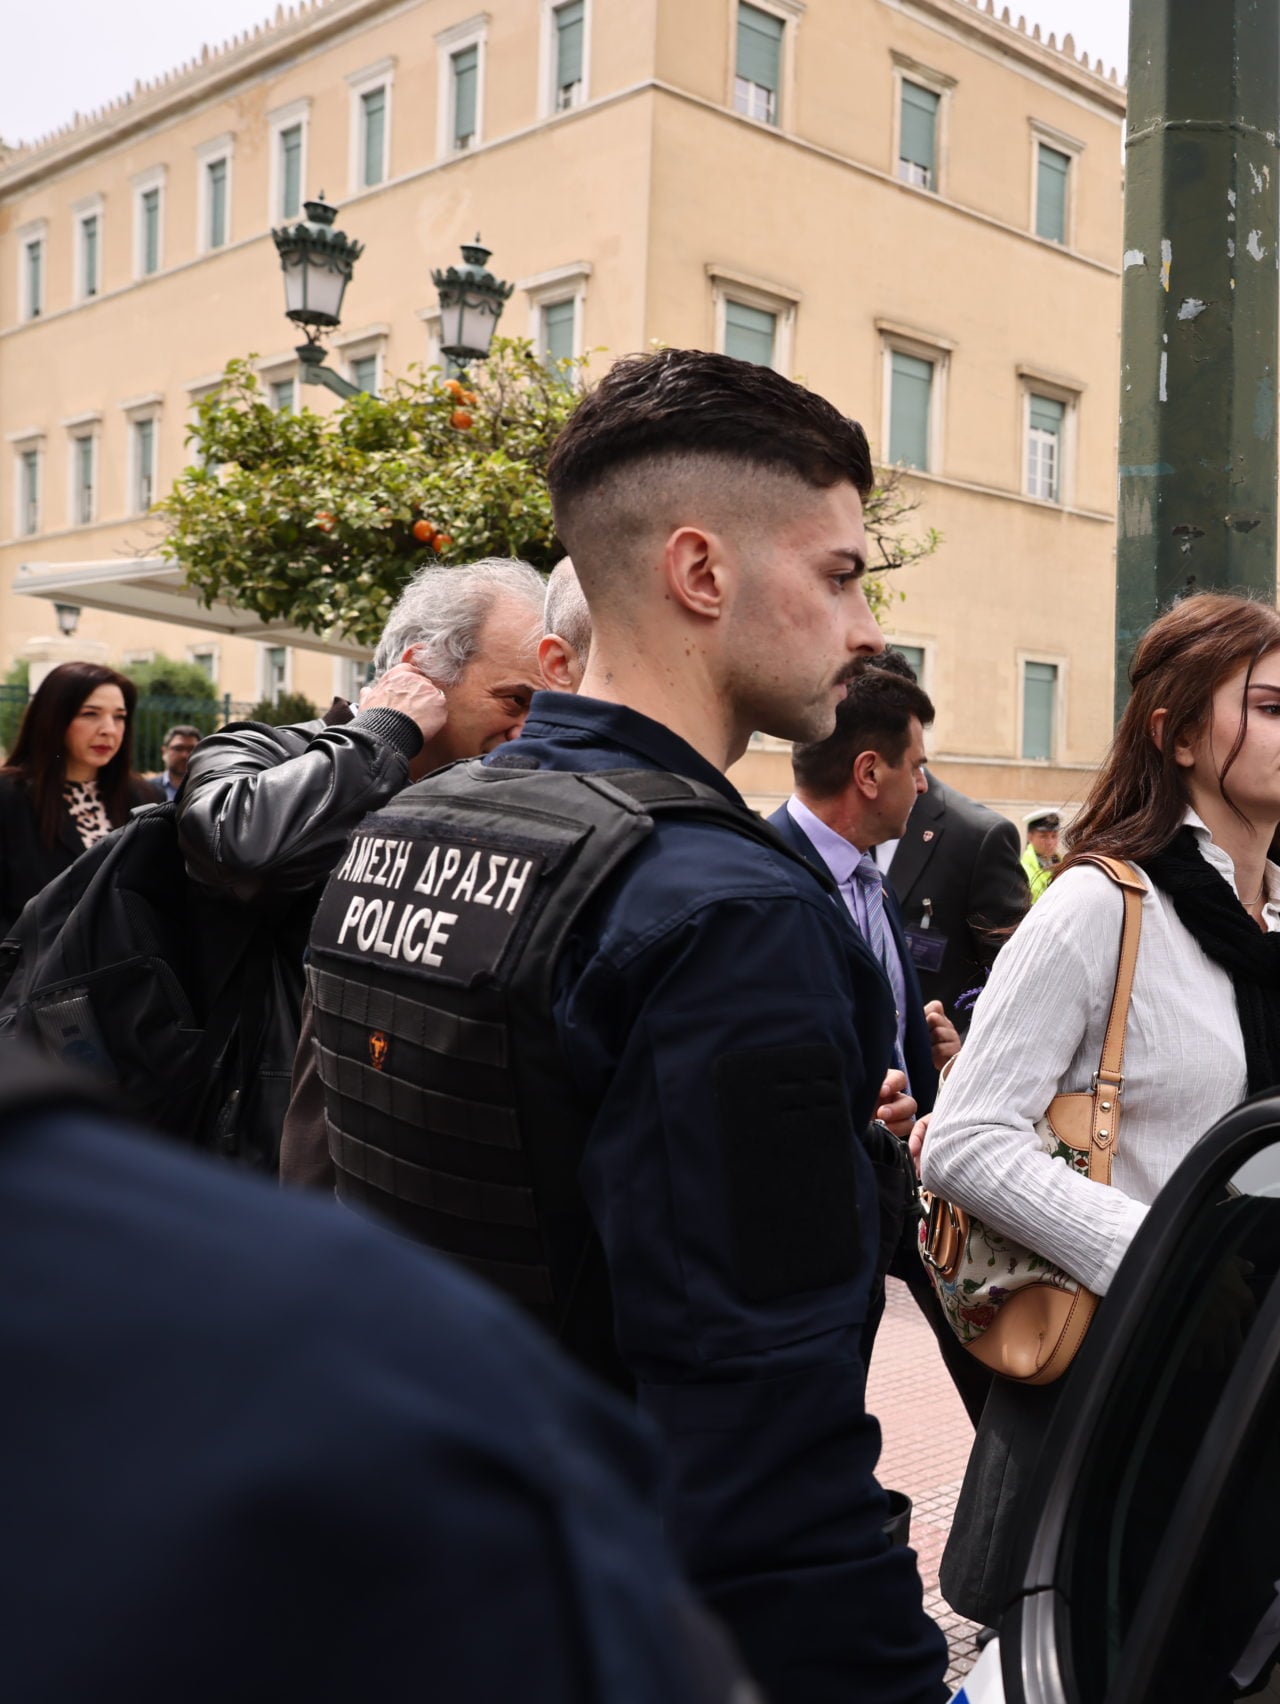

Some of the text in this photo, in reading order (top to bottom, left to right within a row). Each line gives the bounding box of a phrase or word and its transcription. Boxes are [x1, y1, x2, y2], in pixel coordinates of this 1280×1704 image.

[337, 836, 533, 916] ΑΜΕΣΗ ΔΡΑΣΗ
[337, 895, 459, 968] POLICE
